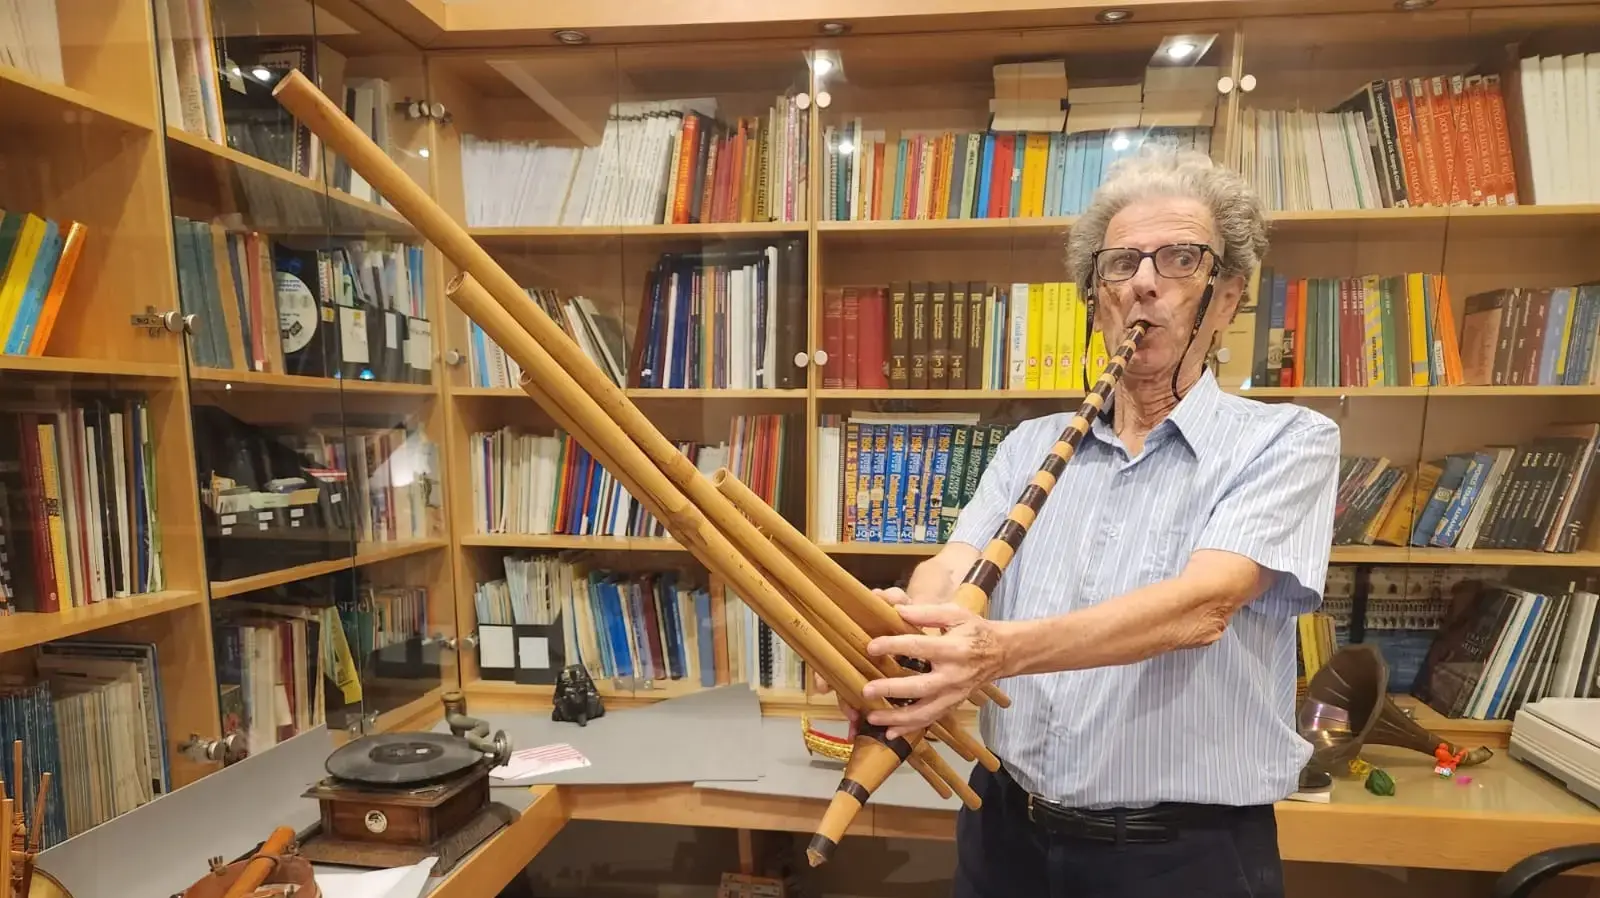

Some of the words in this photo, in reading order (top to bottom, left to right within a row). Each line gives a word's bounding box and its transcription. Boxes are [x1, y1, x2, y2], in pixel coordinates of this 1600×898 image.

[915, 359, 922, 367] 2
[935, 359, 942, 367] 3
[953, 359, 960, 367] 4
[846, 462, 857, 506] STAMPS
